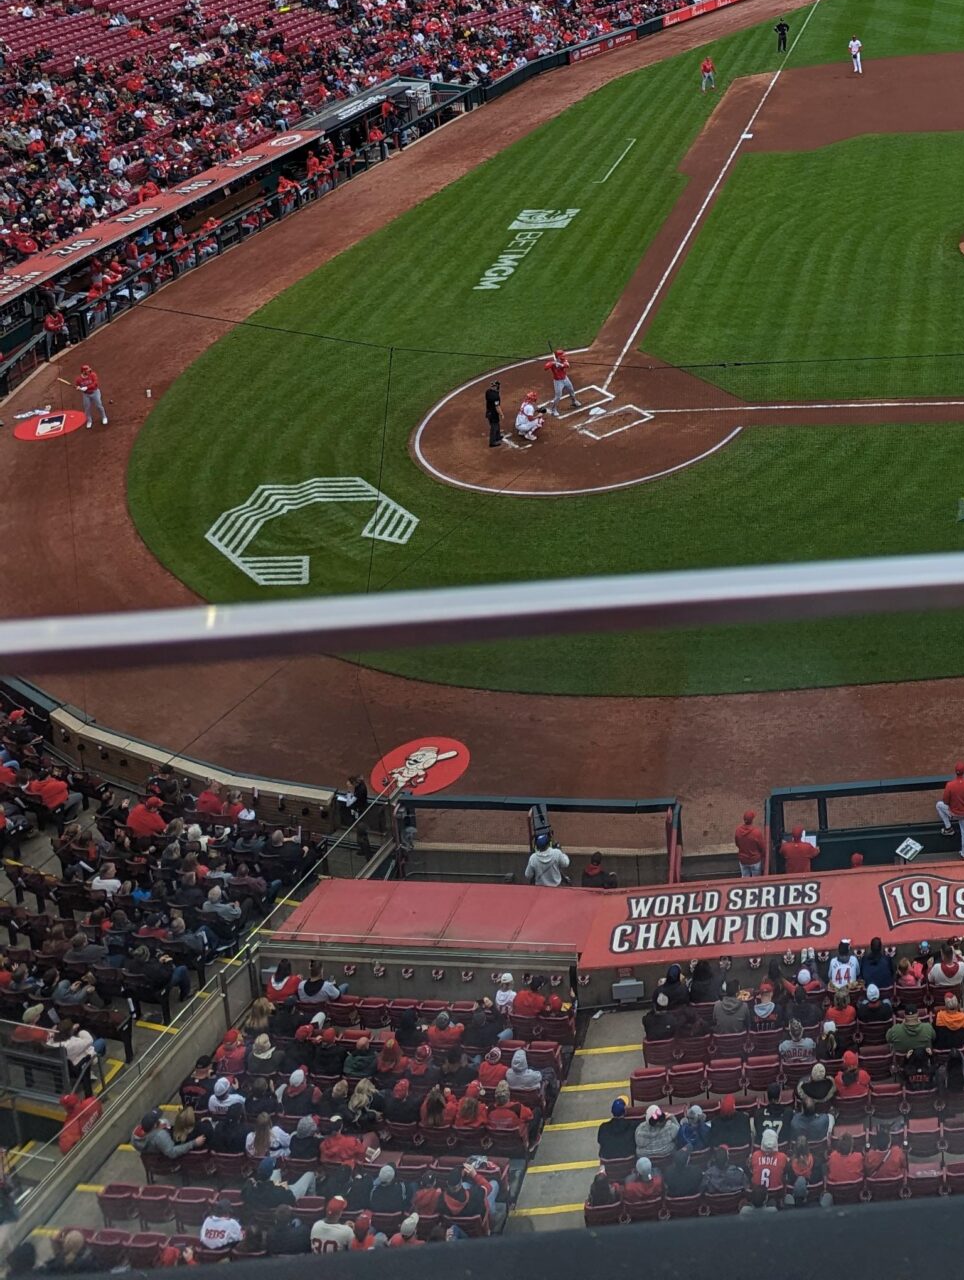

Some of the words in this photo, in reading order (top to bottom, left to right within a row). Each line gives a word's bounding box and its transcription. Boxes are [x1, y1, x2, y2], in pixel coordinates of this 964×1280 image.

[472, 232, 544, 290] BETMGM
[630, 889, 720, 920] WORLD
[725, 882, 820, 912] SERIES
[611, 907, 829, 954] CHAMPIONS
[835, 967, 850, 984] 44
[758, 1156, 777, 1167] INDIA
[761, 1169, 771, 1188] 6
[204, 1228, 226, 1241] REDS
[312, 1238, 337, 1254] 30
